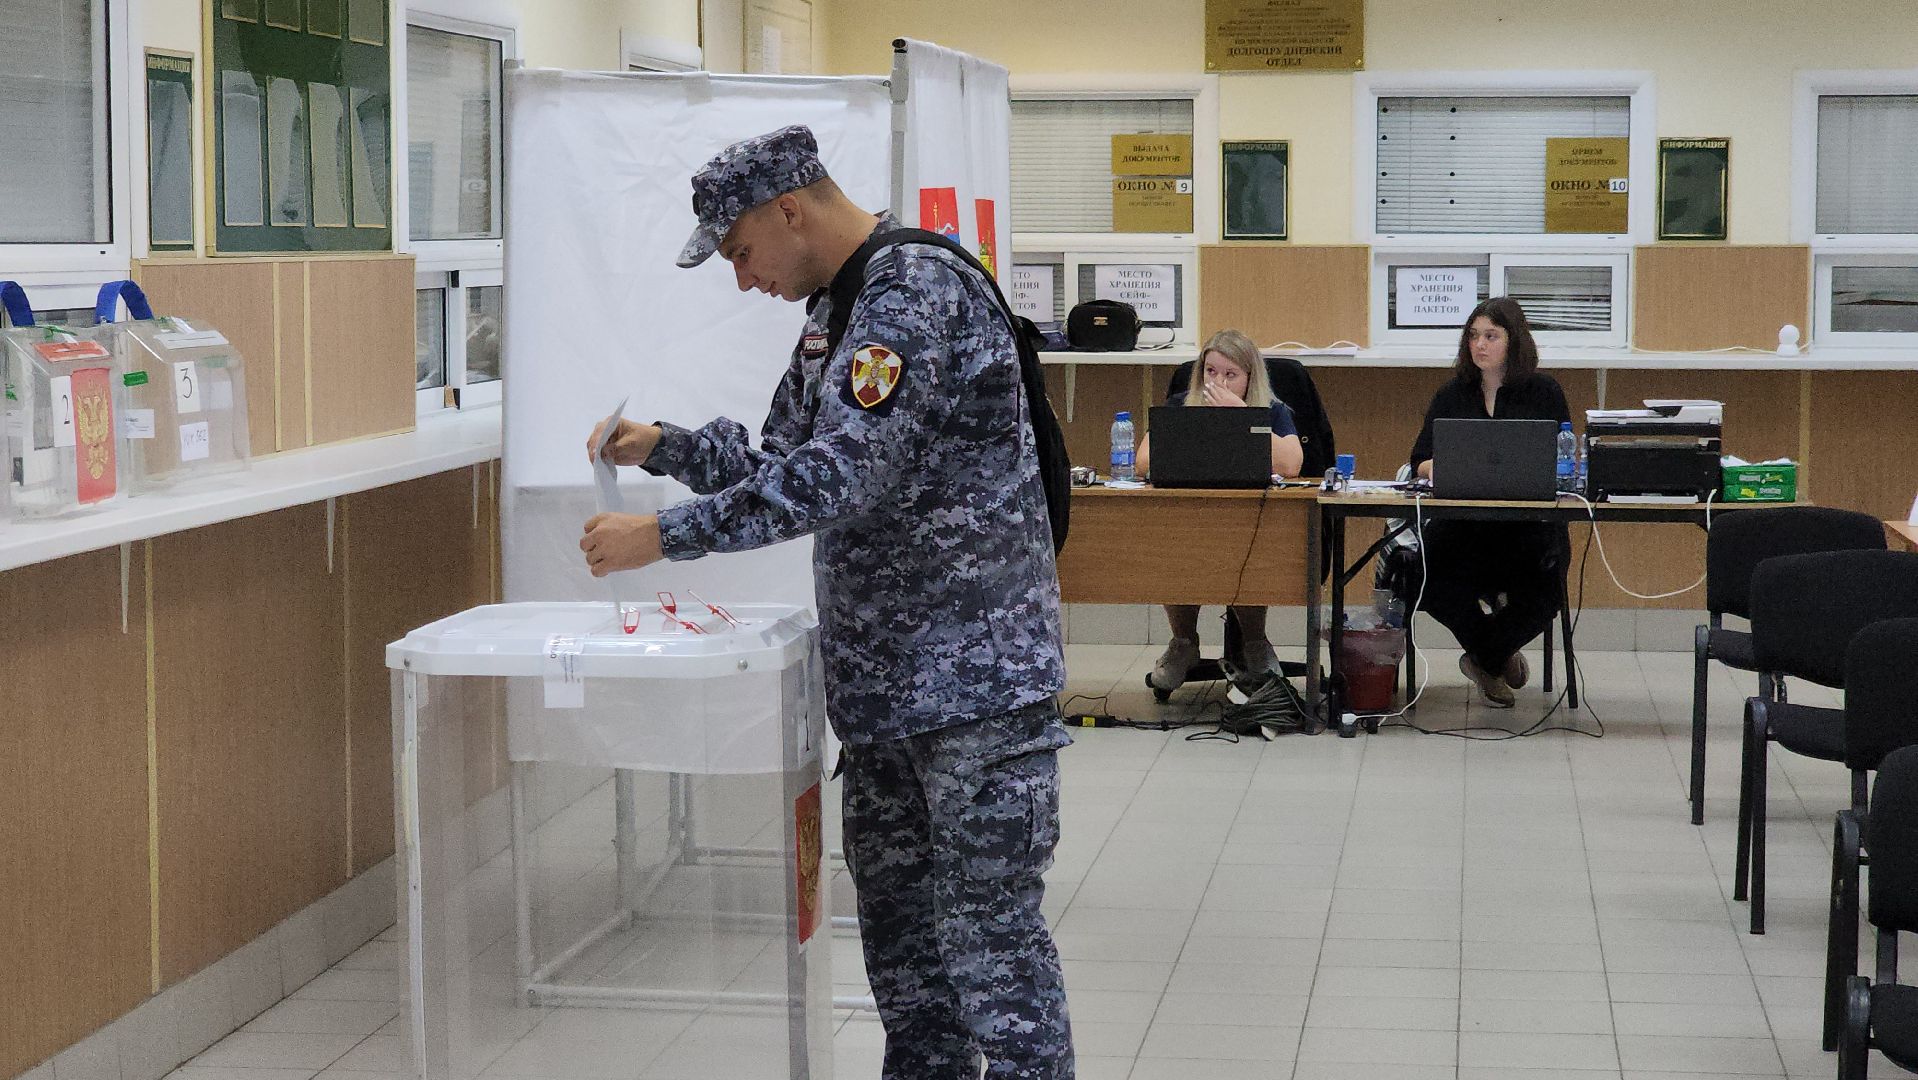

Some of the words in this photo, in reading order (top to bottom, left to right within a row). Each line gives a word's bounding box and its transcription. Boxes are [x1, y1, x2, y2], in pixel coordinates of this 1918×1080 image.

[1226, 46, 1343, 57] ДОЛГОПРУДНЕНСКИЙ
[1266, 58, 1302, 67] ОТДЕЛ
[1225, 143, 1287, 151] ИНФОРМАЦИЯ
[1662, 141, 1727, 149] ИНФОРМАЦИЯ
[1122, 155, 1181, 163] ДОКУМЕНТОВ
[1118, 181, 1157, 191] ОКНО
[1180, 182, 1188, 192] 9
[1551, 180, 1591, 191] ОКНО
[1612, 181, 1626, 191] 10
[1109, 280, 1161, 289] ХРАНЕНИЯ
[1410, 284, 1463, 292] ХРАНЕНИЯ
[1120, 290, 1152, 299] СЕЙФ-
[1421, 294, 1453, 302] СЕЙФ-
[1414, 305, 1460, 313] ПАКЕТОВ
[180, 367, 193, 399] 3
[62, 394, 71, 425] 2
